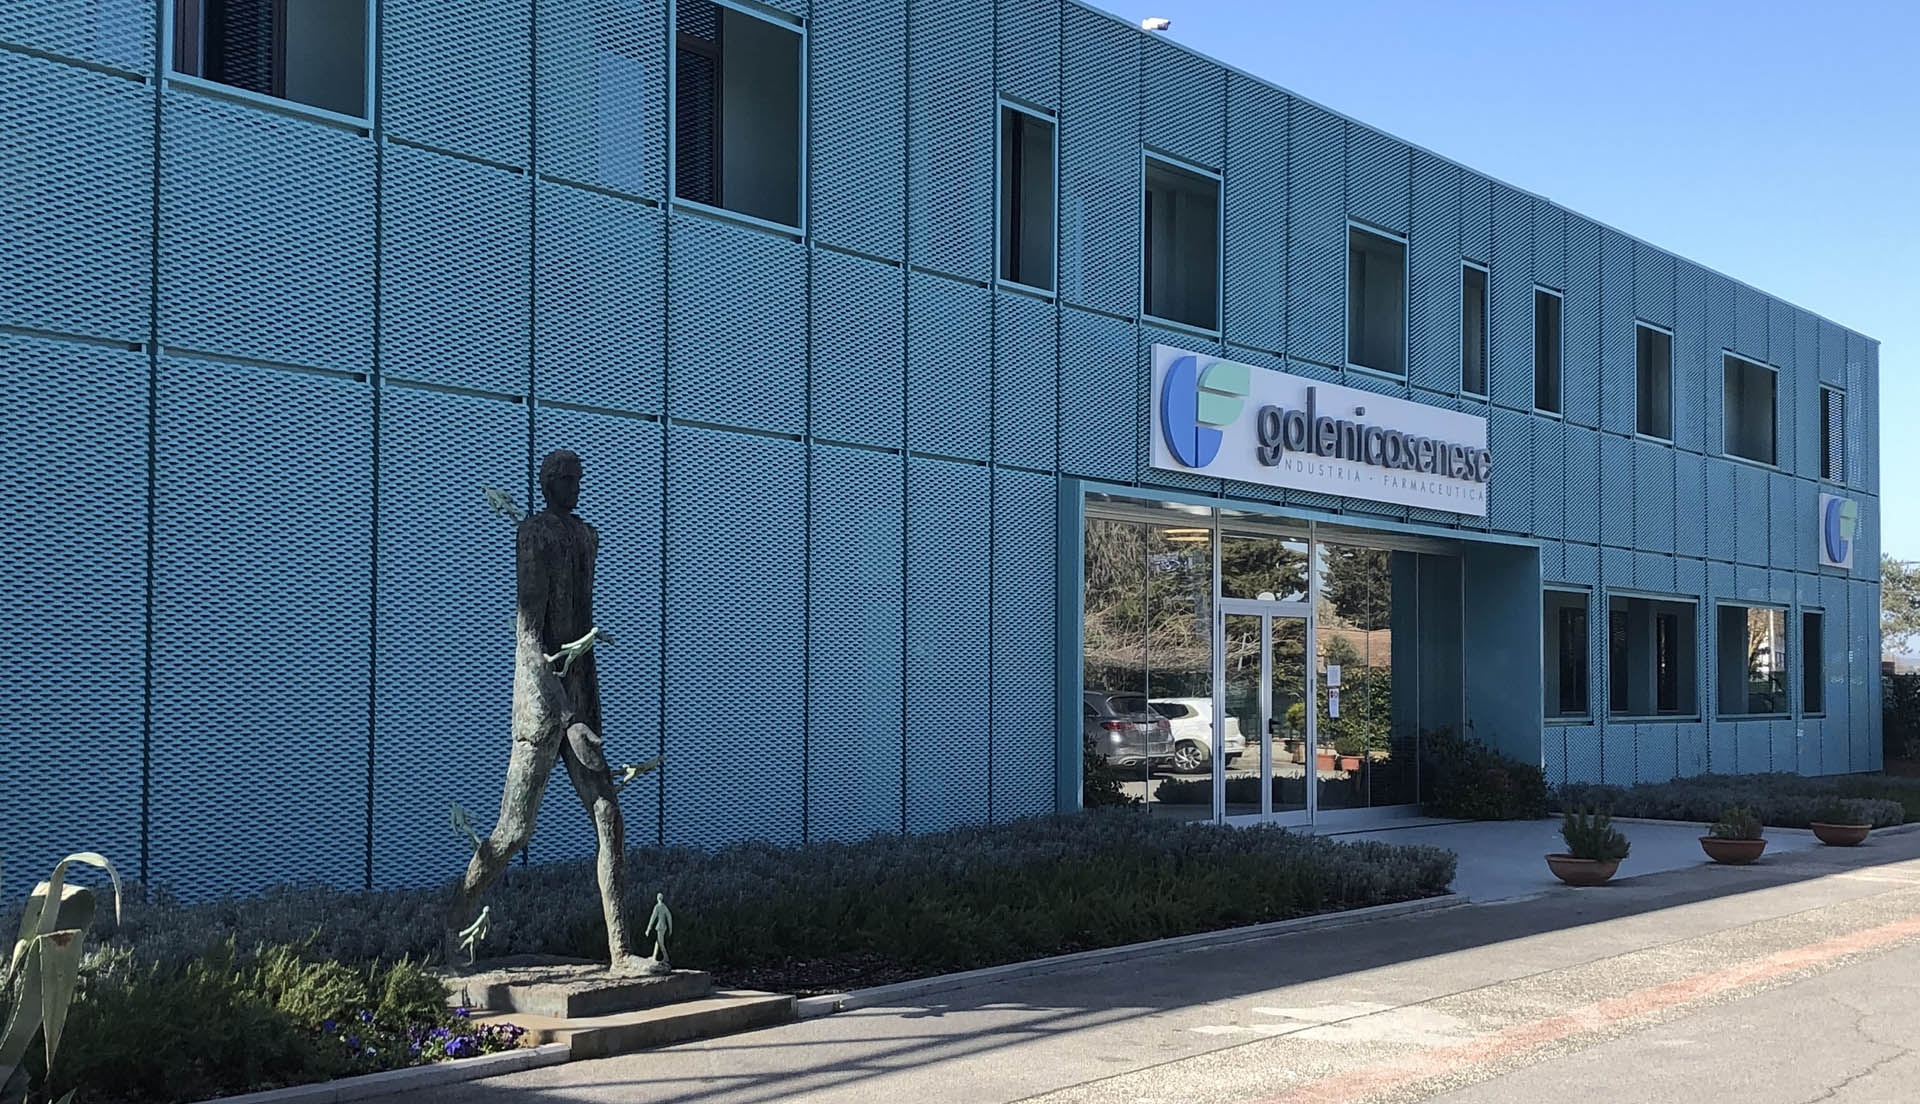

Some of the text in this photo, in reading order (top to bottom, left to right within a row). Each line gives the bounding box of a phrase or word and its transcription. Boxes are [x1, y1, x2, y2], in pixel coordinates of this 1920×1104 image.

[1257, 386, 1492, 483] galenicasenese
[1276, 458, 1361, 482] NDUSTRIA
[1384, 475, 1484, 502] FARMACEUTICA
